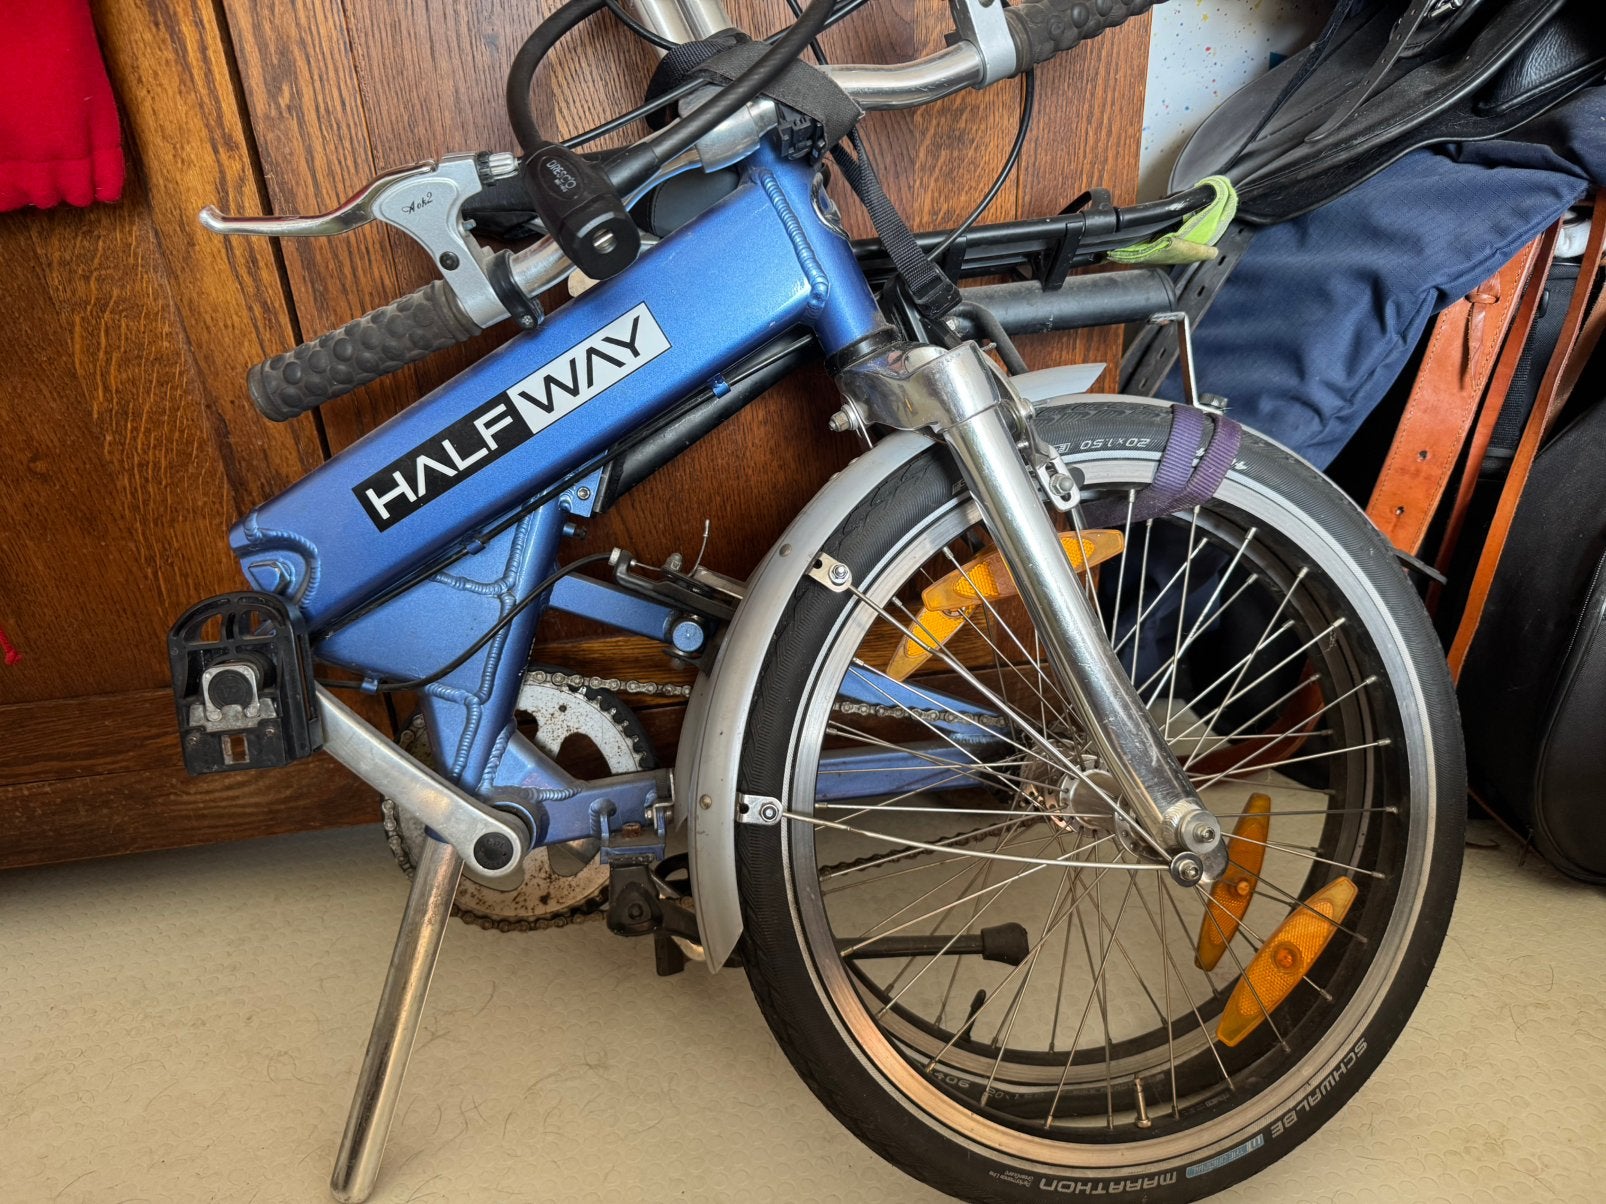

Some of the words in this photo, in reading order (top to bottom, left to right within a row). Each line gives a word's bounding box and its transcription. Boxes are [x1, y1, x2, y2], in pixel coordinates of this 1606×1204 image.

[366, 315, 640, 519] HALFWAY
[1080, 438, 1150, 449] 20x1.50
[934, 1071, 970, 1088] 406
[1269, 1037, 1368, 1138] SCHWALBE
[1039, 1170, 1177, 1194] MARATHON
